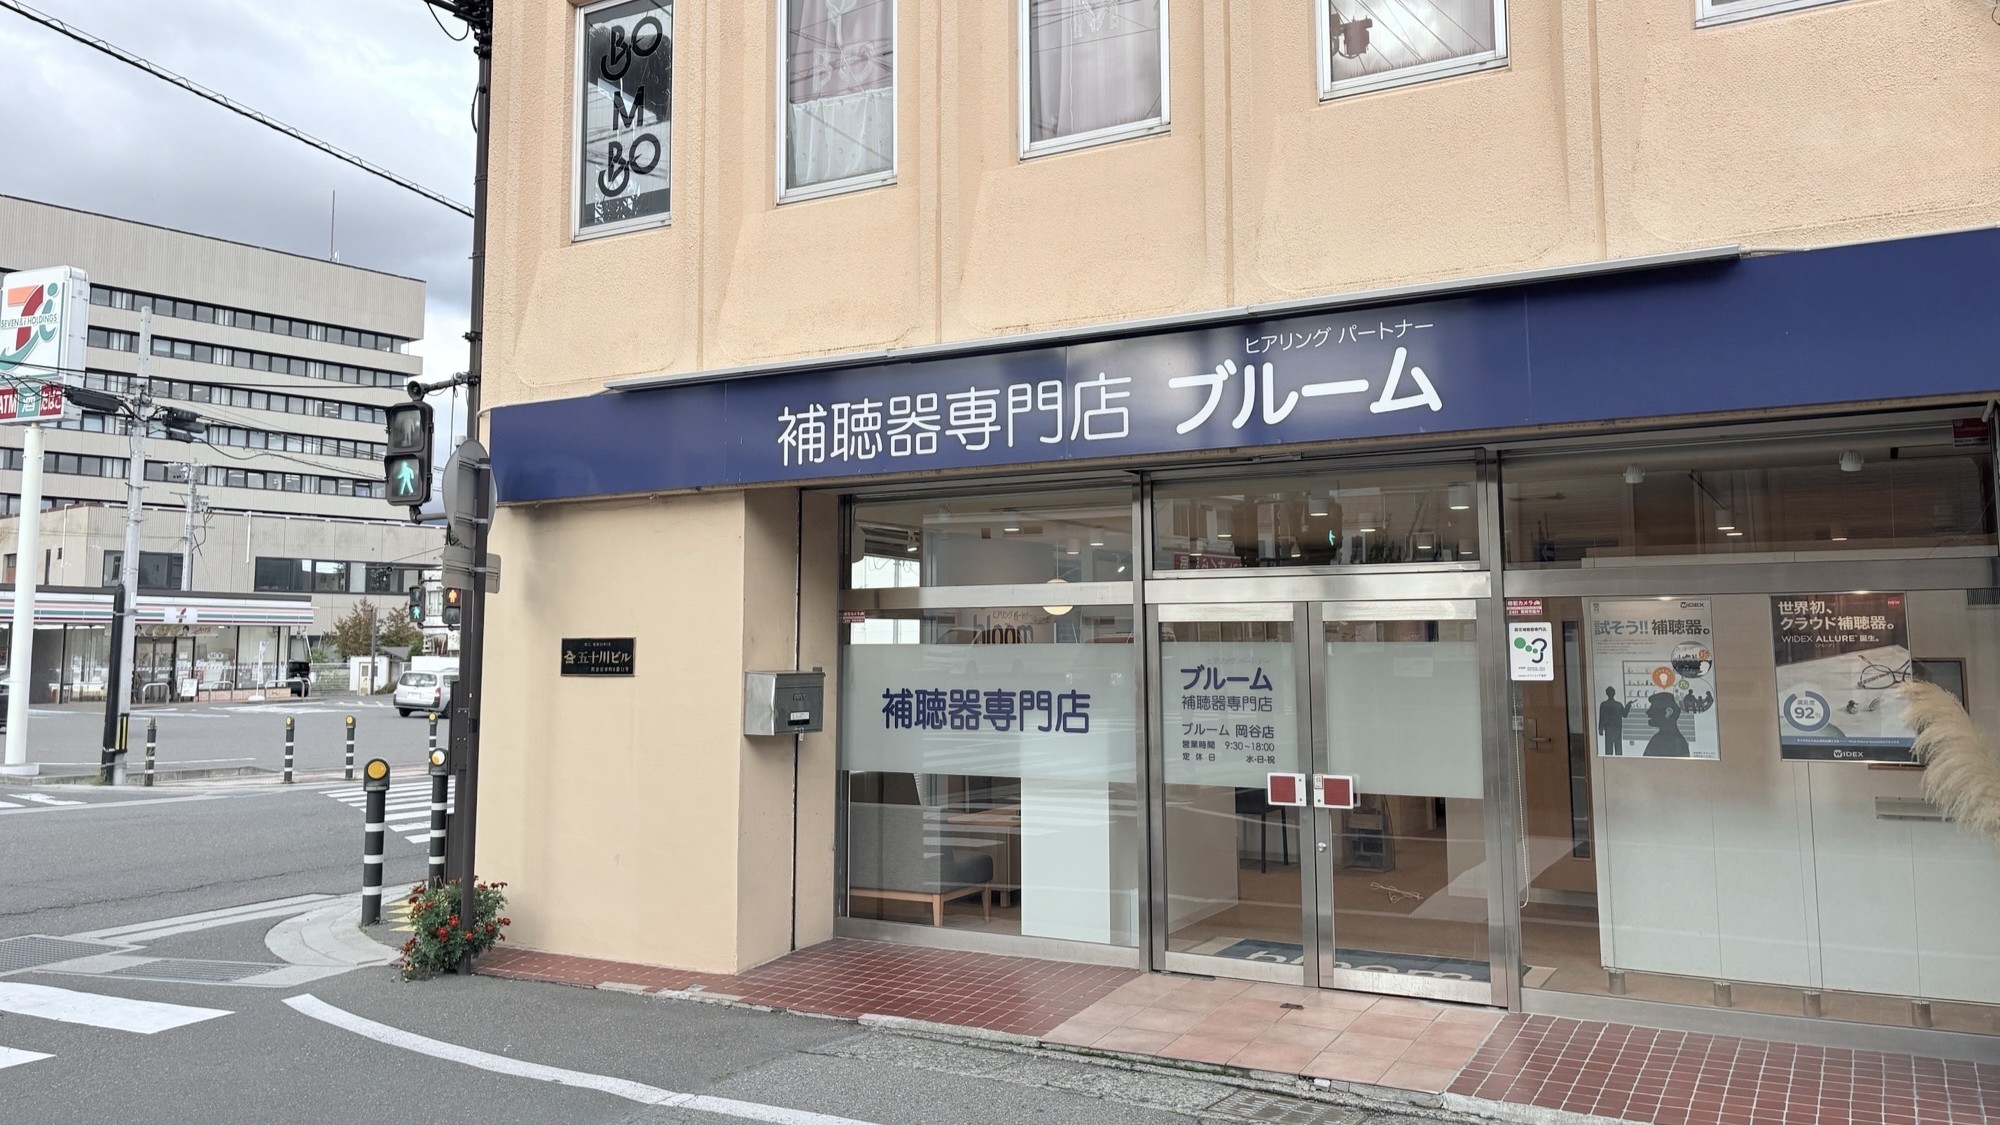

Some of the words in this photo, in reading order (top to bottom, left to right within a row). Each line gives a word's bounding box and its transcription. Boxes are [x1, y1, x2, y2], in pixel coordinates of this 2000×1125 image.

[28, 313, 58, 325] HOLDINGS
[1246, 326, 1332, 354] ヒアリング
[1338, 318, 1434, 344] パートナー
[777, 372, 1132, 467] 補聴器専門店
[1168, 346, 1443, 435] ブルーム
[1778, 600, 1833, 615] 世界初、
[1651, 619, 1710, 636] 補聴器。
[1780, 615, 1895, 631] クラウド補聴器。
[1781, 635, 1813, 643] WIDEX
[1180, 664, 1273, 691] ブルーム
[882, 687, 1091, 733] 補聴器専門店
[1182, 695, 1273, 712] 補聴器専門店
[1182, 722, 1230, 736] ブルーム
[1235, 724, 1275, 739] 岡谷店
[1182, 740, 1216, 750] 営業時間
[1833, 749, 1864, 758] WIDEX
